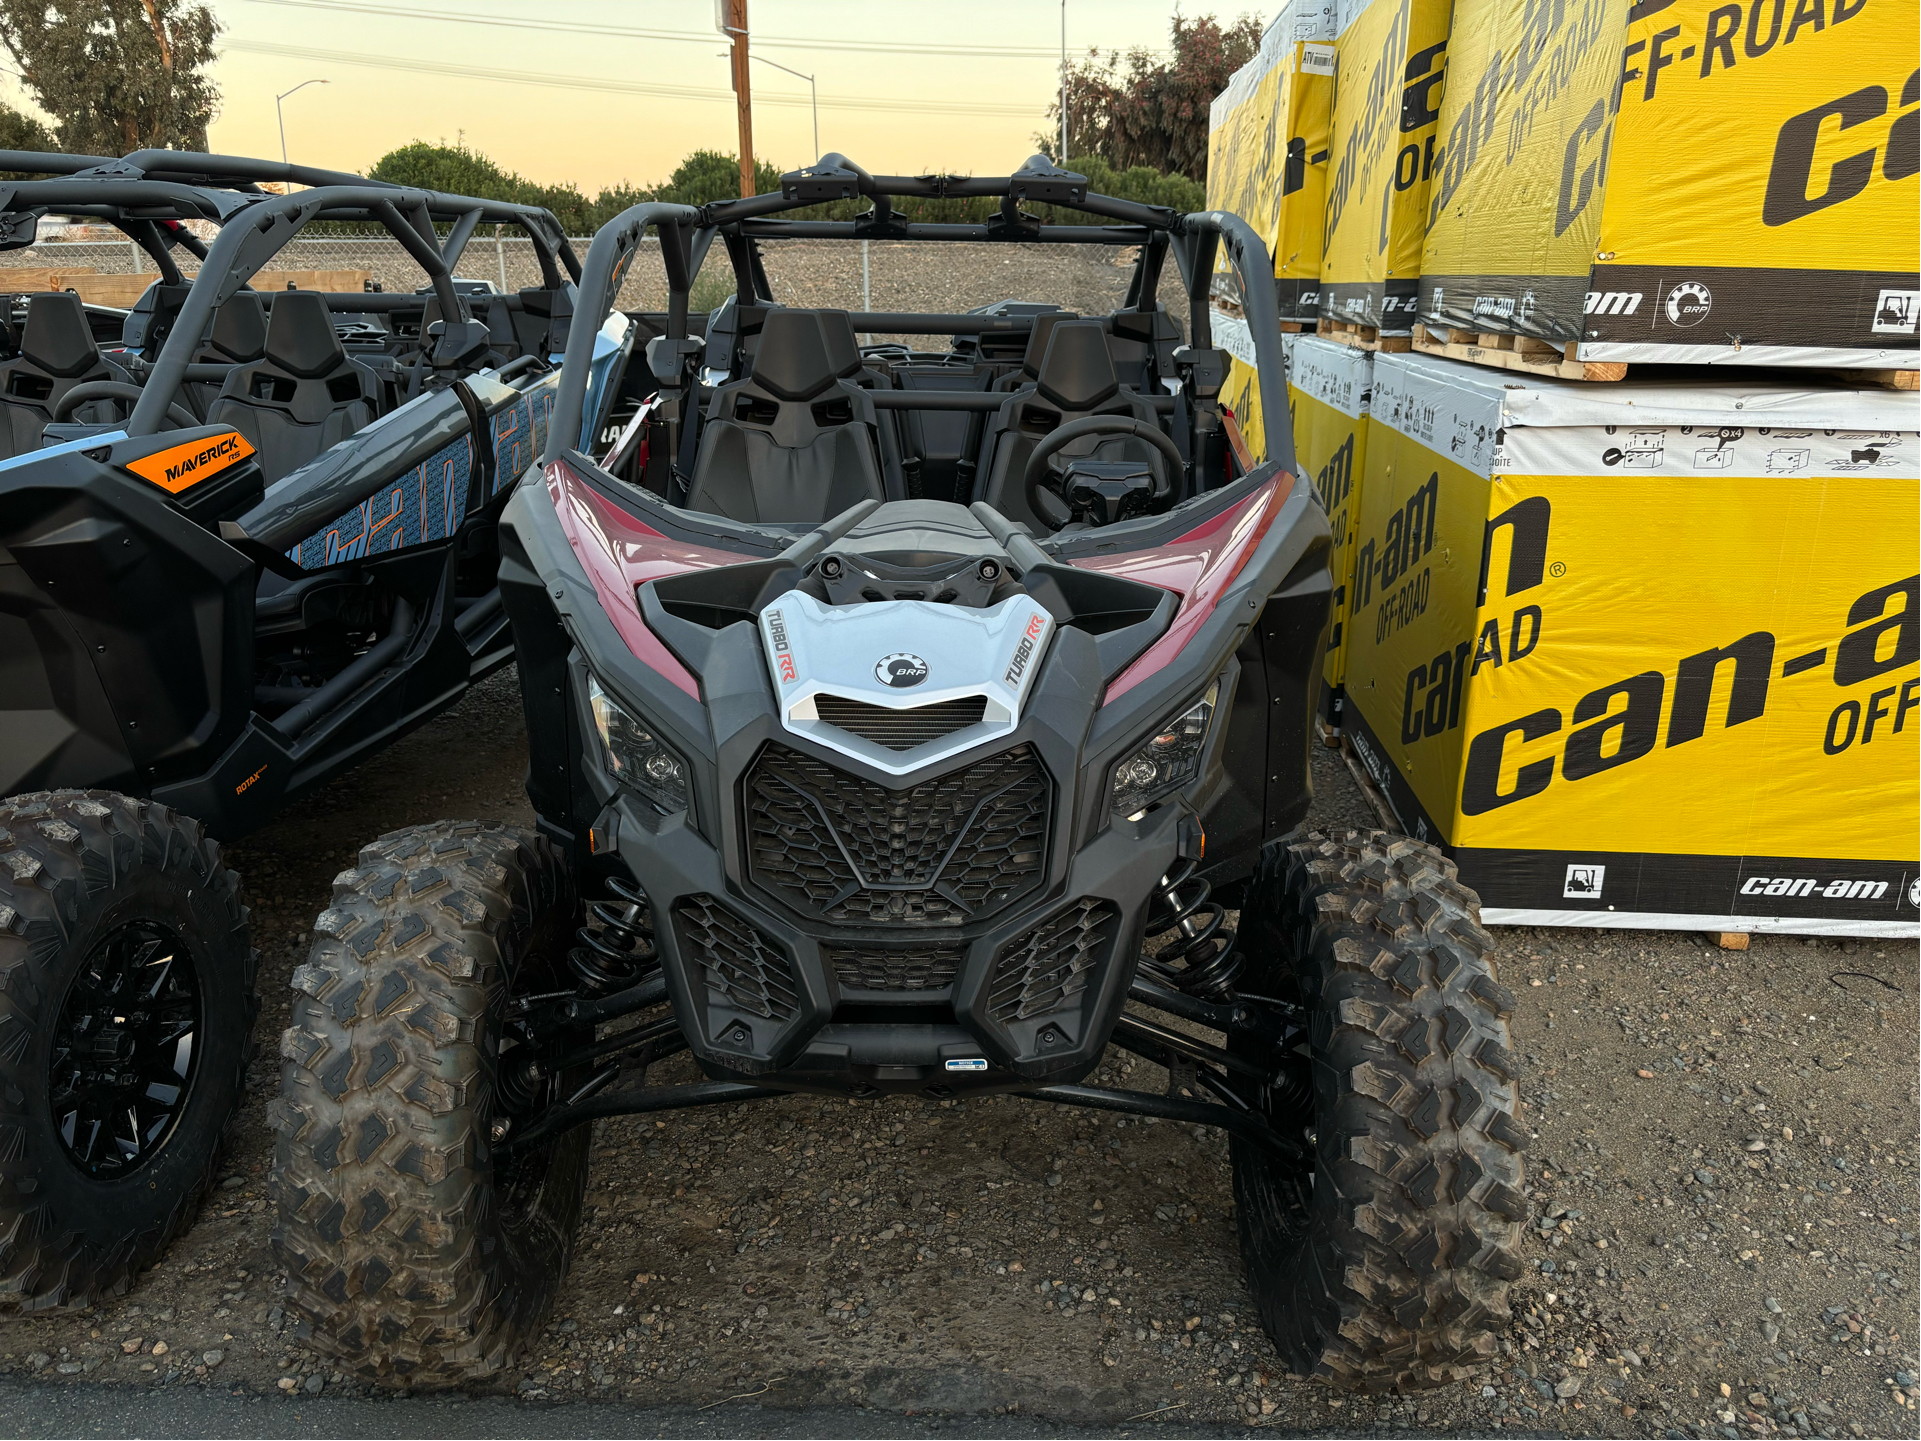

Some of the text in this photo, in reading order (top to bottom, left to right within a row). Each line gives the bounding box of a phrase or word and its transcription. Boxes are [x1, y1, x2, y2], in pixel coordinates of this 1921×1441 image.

[1473, 296, 1515, 316] can-am
[1683, 306, 1708, 314] BRP
[1730, 428, 1742, 438] x4
[164, 436, 239, 483] MAVERICK
[228, 451, 241, 462] RS
[1376, 566, 1430, 646] OFF-ROAD
[766, 609, 796, 684] TURBO RR
[1004, 613, 1046, 686] TURBO RR
[895, 667, 927, 677] BRP
[236, 771, 260, 795] ROTAX
[1739, 876, 1889, 900] can-am
